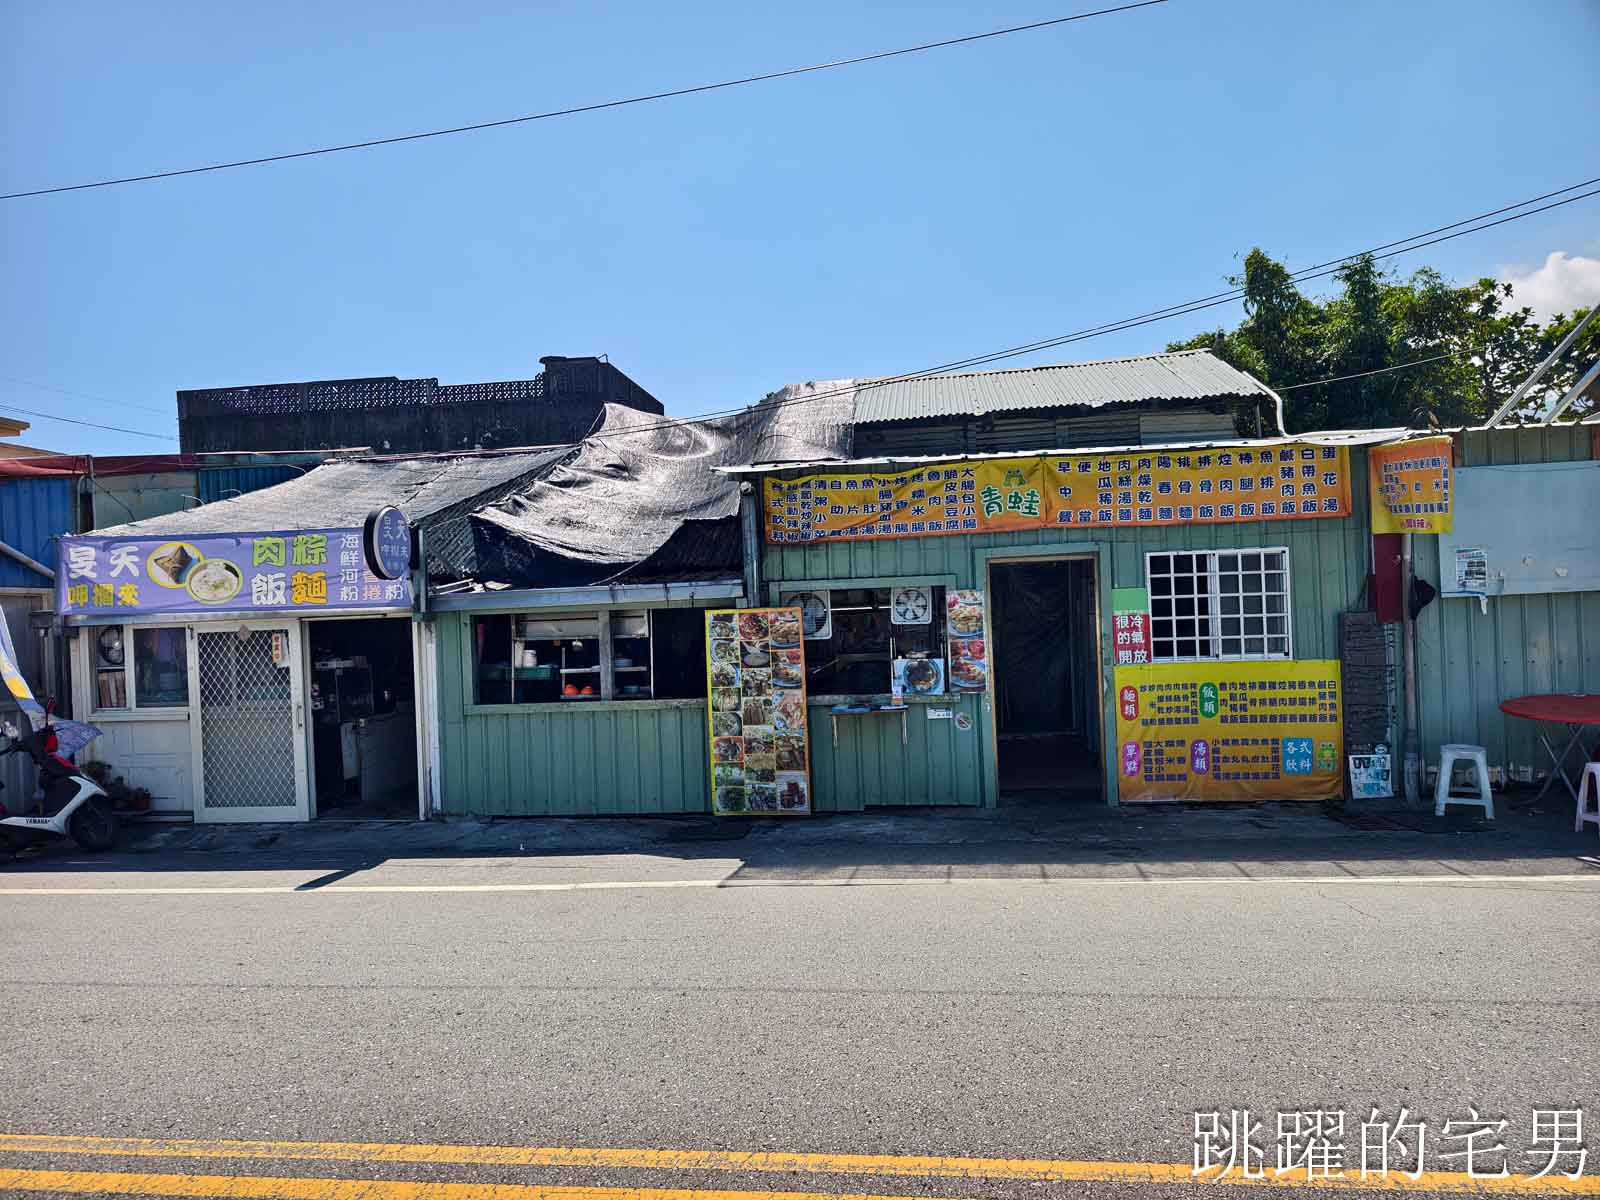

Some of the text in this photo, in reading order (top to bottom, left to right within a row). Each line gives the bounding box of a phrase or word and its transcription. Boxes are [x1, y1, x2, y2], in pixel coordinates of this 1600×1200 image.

[845, 479, 860, 537] 魚片湯
[861, 479, 876, 535] 魚肚湯
[878, 478, 893, 535] 小腸豬血湯
[895, 476, 909, 534] 烤香腸
[911, 473, 926, 533] 烤糯米腸
[927, 470, 943, 532] 魯肉飯
[944, 468, 960, 531] 脆皮臭豆腐
[961, 467, 977, 530] 大腸包小腸
[980, 485, 1041, 518] 青蛙
[1057, 461, 1073, 524] 早中餐
[1078, 461, 1093, 523] 便當
[1097, 460, 1114, 523] 地瓜稀飯
[1117, 458, 1133, 522] 肉絲湯麵
[1137, 457, 1153, 521] 肉燥乾麵
[1157, 456, 1174, 521] 陽春麵
[1176, 456, 1193, 520] 排骨麵
[1197, 454, 1214, 519] 排骨飯
[1238, 452, 1255, 516] 棒腿飯
[1259, 451, 1276, 516] 魚排飯
[1279, 448, 1296, 515] 鹹豬肉飯
[1300, 448, 1317, 514] 白帶魚飯
[1322, 447, 1338, 512] 蛋花湯
[252, 534, 328, 568] 肉粽
[340, 533, 360, 601] 海鮮河粉
[251, 571, 328, 605] 飯麵
